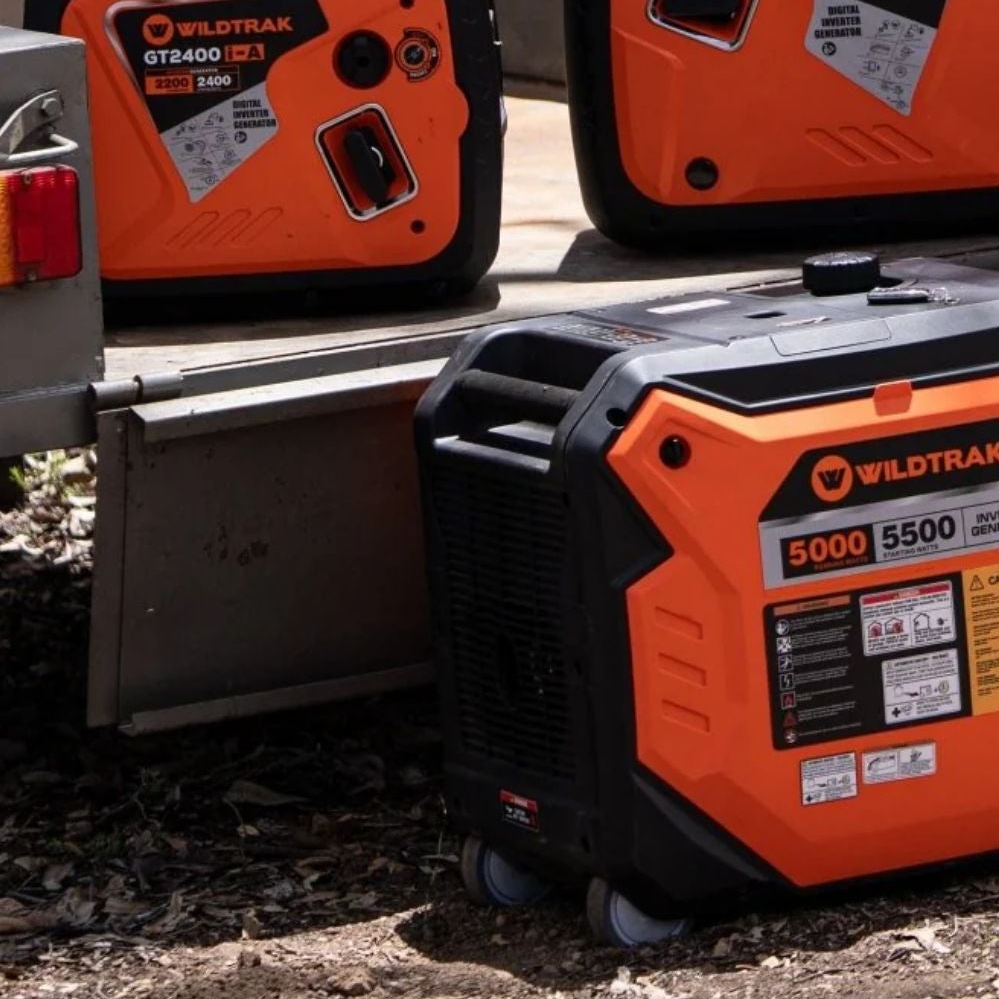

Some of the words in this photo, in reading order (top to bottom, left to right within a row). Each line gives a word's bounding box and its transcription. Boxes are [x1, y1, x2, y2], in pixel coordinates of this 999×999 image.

[828, 5, 860, 16] DIGITAL
[176, 17, 293, 37] WILDTRAK
[821, 16, 861, 27] INVERTER
[813, 27, 862, 39] GENERATOR
[144, 47, 221, 65] GT2400
[227, 45, 263, 61] i-A
[155, 77, 189, 89] 2200
[197, 74, 231, 87] 2400
[233, 99, 262, 109] DIGITAL
[789, 530, 868, 567] 5000
[882, 514, 957, 550] 5500
[883, 547, 916, 559] STARTING
[917, 543, 939, 553] WATTS
